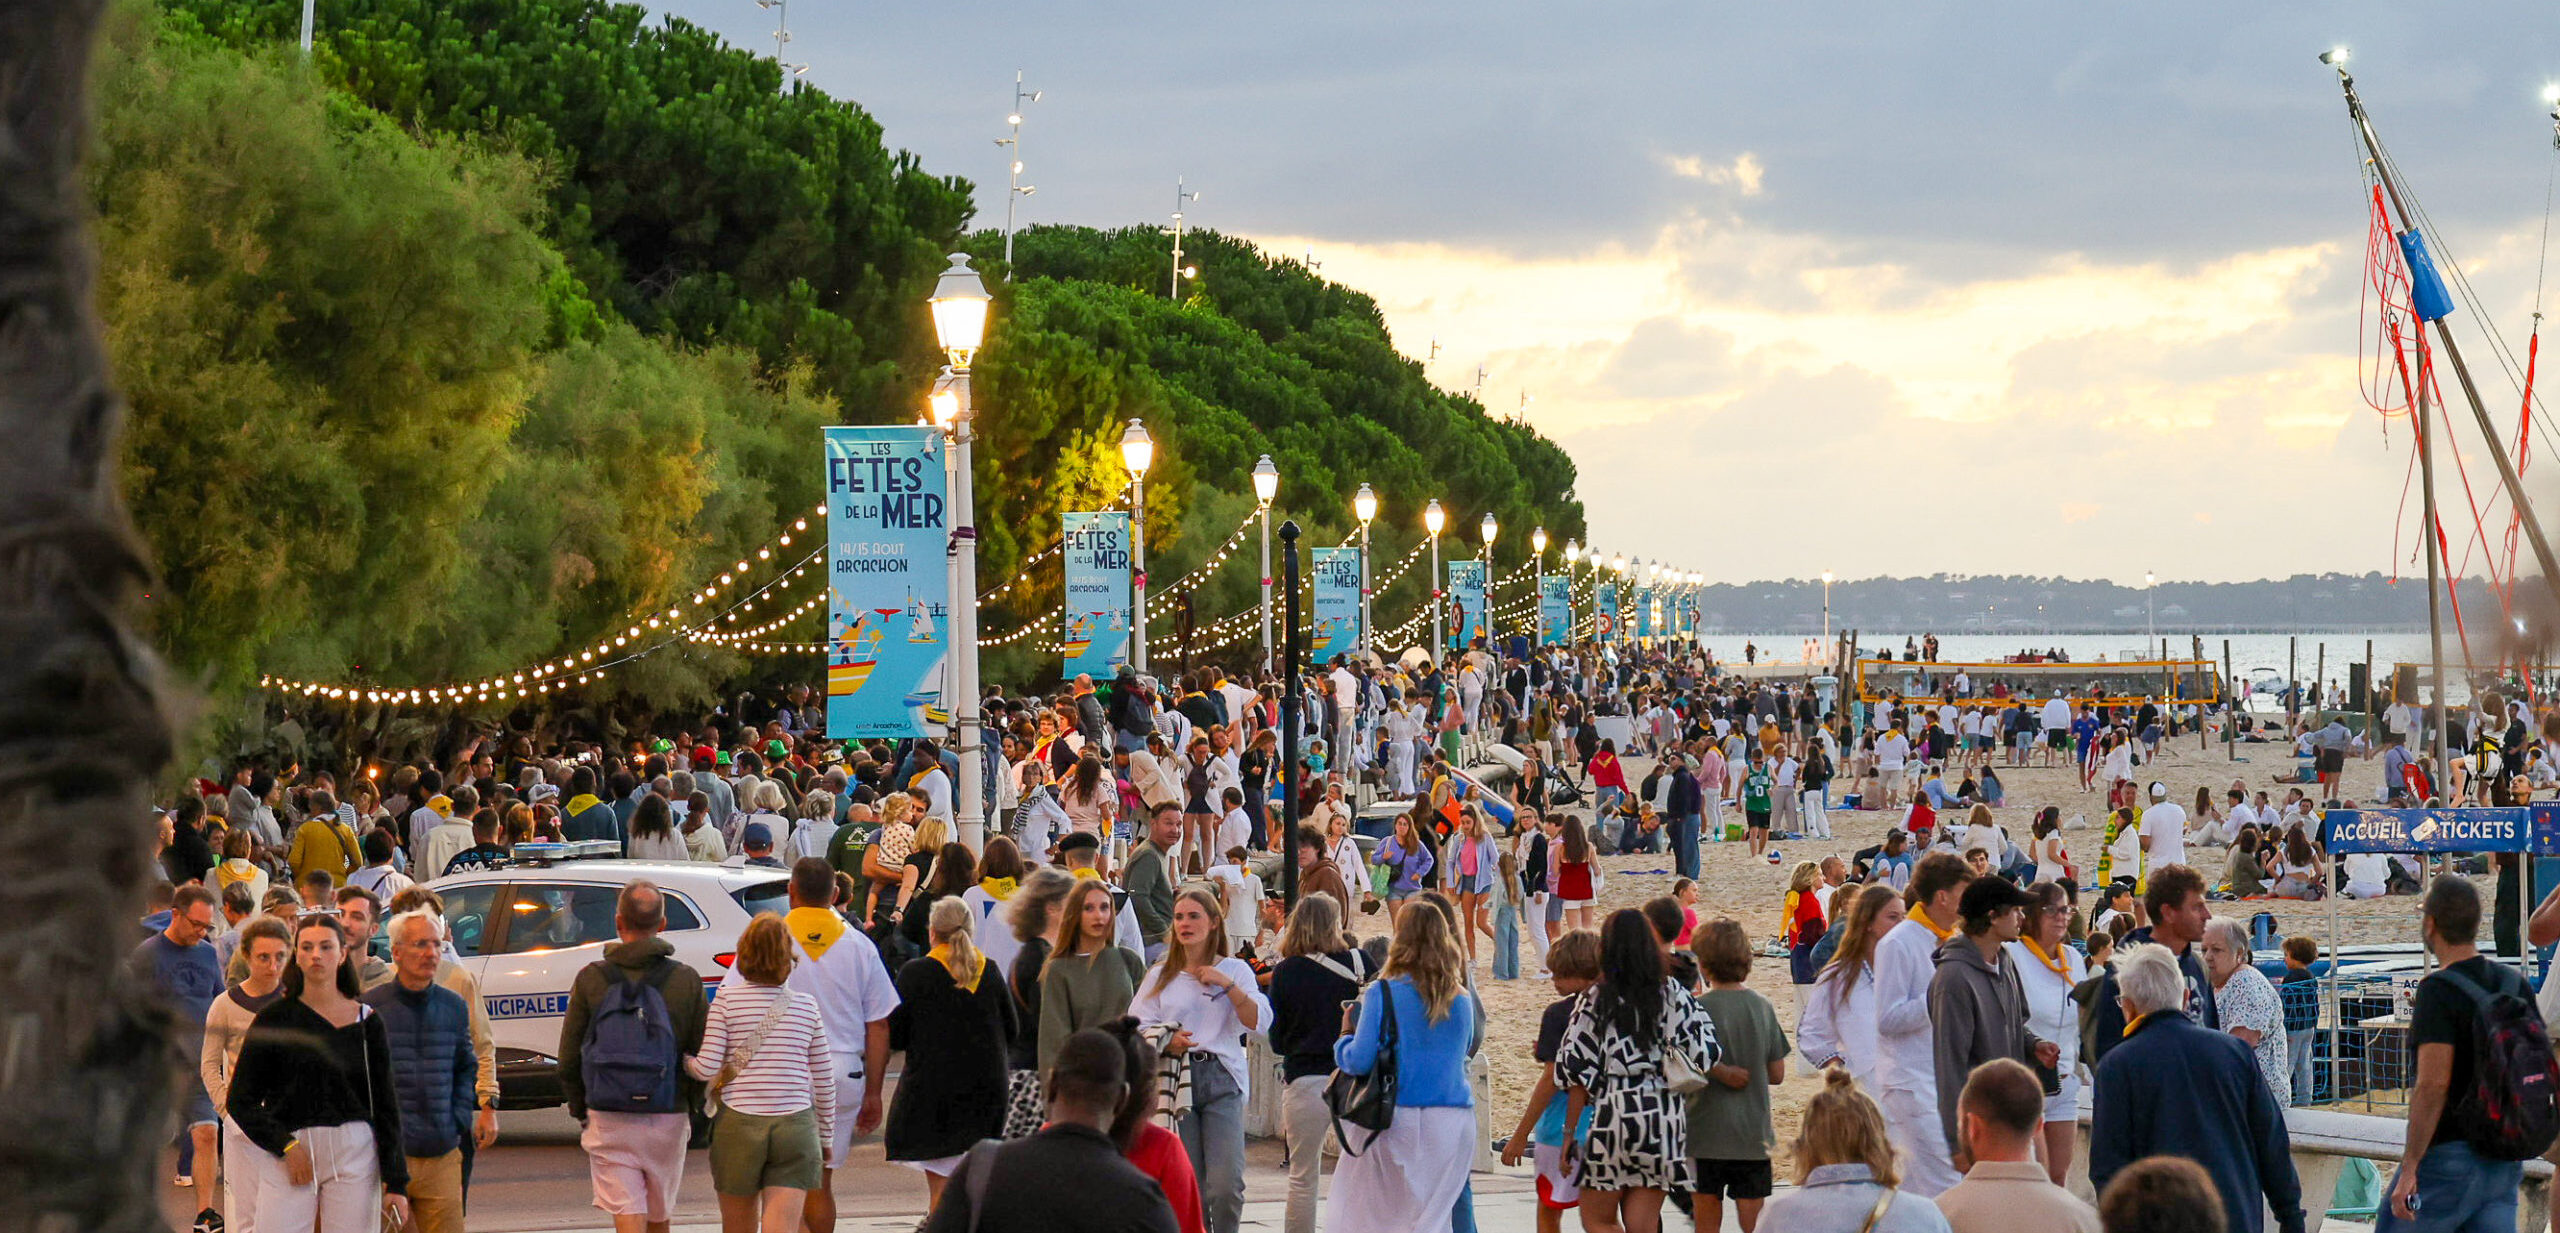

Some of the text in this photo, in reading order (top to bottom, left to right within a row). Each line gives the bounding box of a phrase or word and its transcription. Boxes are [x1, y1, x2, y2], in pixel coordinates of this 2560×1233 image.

[871, 443, 891, 455] LES
[829, 451, 922, 493] FÊTES
[845, 493, 943, 529] DE LA MER
[840, 542, 869, 556] 14/15
[836, 559, 908, 573] ARCACHON
[1074, 550, 1128, 569] DE LA MER
[1334, 575, 1358, 588] MER
[1069, 585, 1109, 593] ARCACHON
[2333, 820, 2515, 841] ACCUEIL TICKETS
